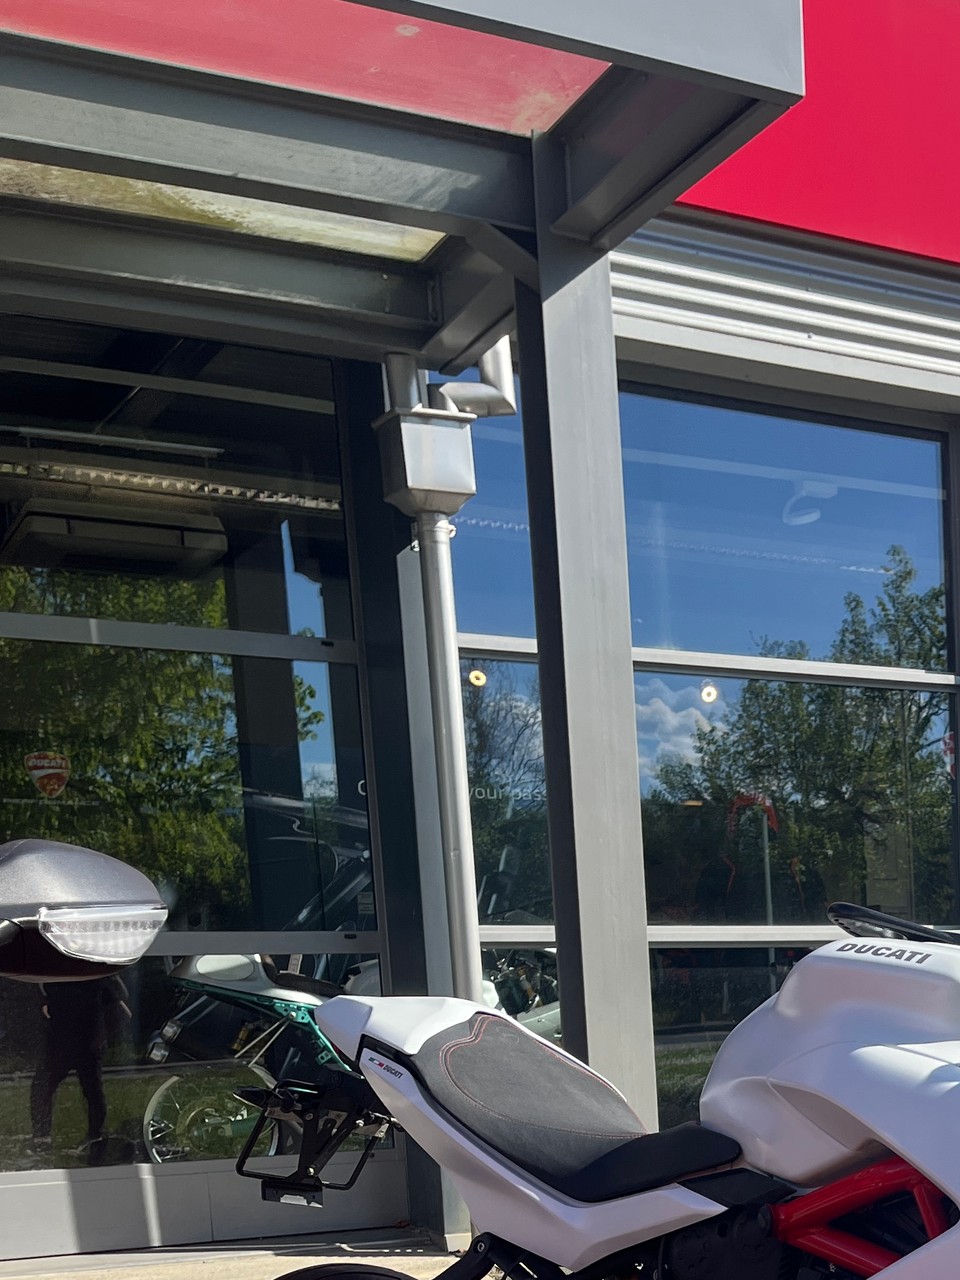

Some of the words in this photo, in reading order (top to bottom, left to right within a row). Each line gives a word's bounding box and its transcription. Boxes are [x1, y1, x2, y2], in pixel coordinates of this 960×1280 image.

[29, 758, 66, 767] DUCATI
[836, 943, 932, 965] DUCATI
[382, 1064, 404, 1079] DUCATI
